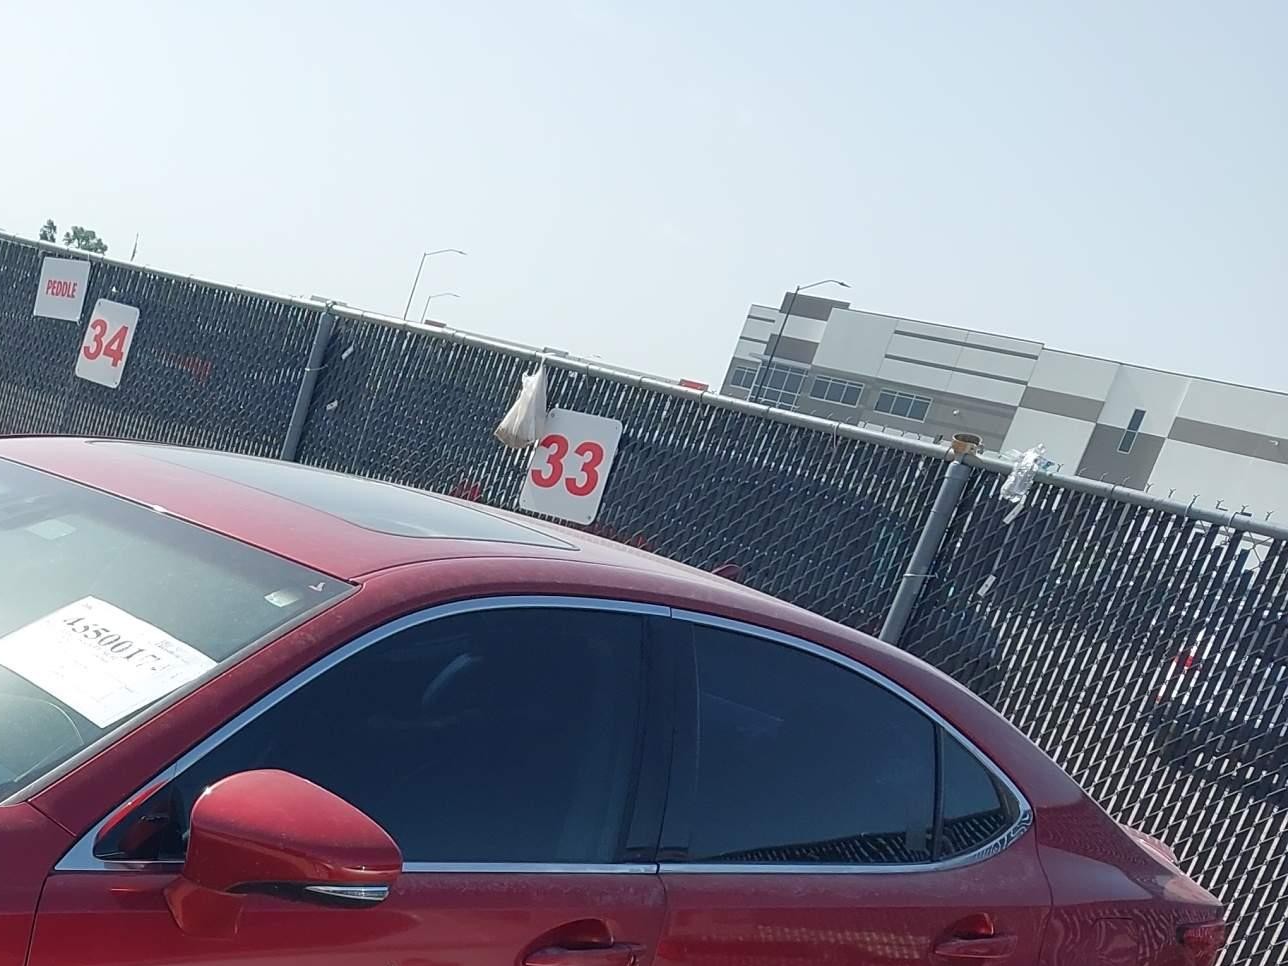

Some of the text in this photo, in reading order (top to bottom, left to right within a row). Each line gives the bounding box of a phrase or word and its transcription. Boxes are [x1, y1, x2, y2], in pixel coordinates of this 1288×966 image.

[46, 280, 77, 298] PEDDLE
[83, 318, 129, 368] 34
[531, 434, 604, 496] 33
